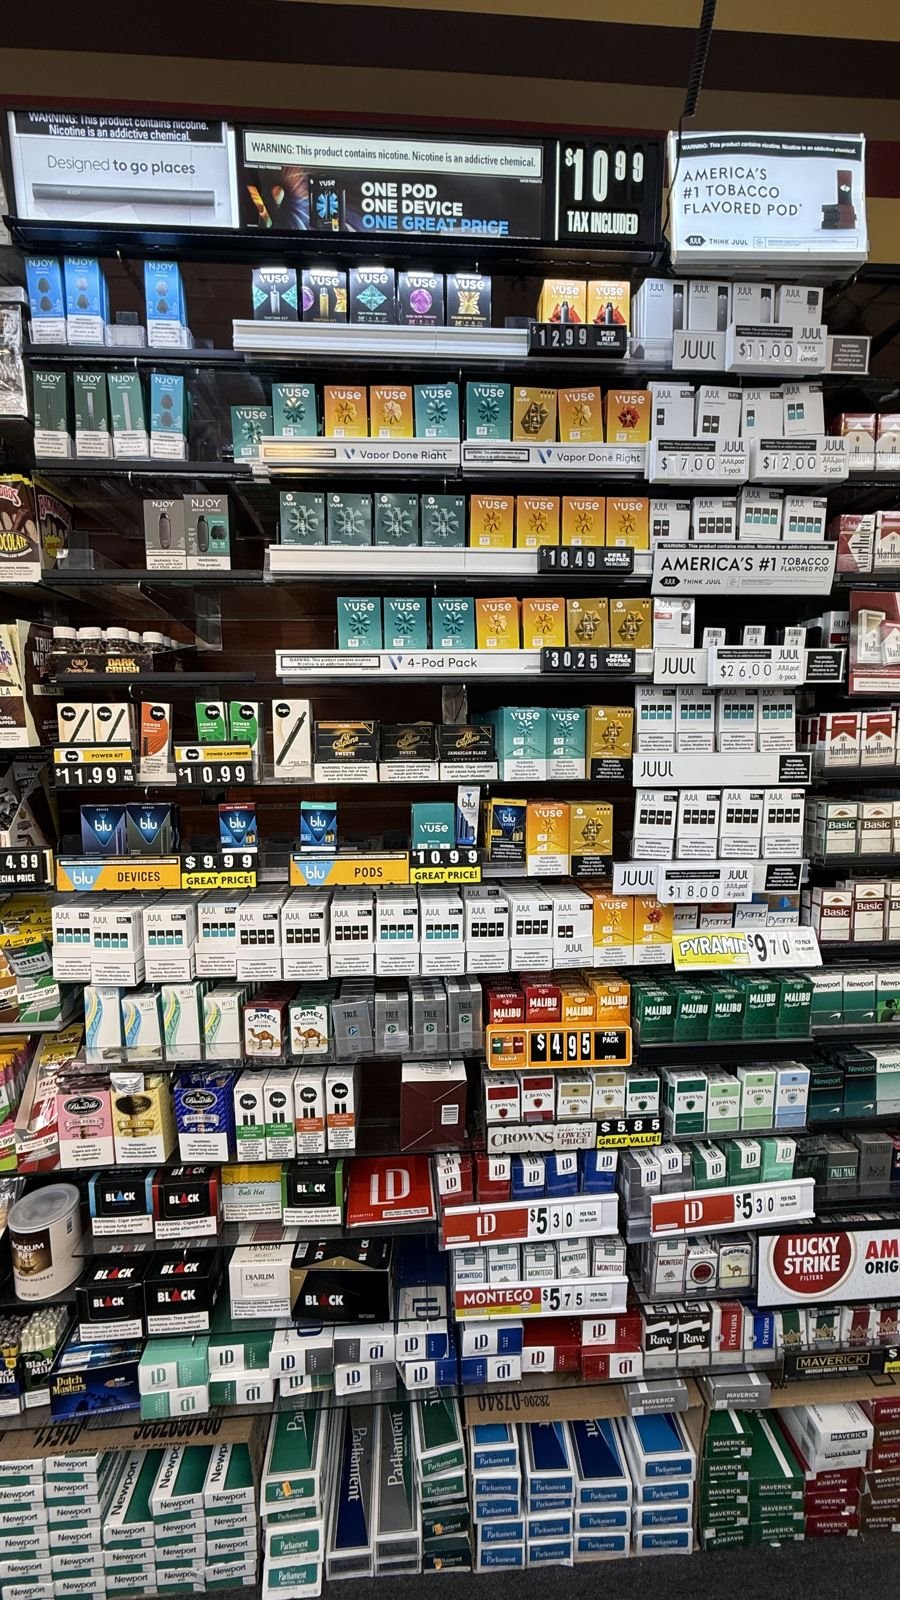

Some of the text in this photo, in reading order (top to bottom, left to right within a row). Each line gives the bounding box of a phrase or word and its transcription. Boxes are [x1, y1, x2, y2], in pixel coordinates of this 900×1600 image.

[29, 112, 208, 130] WARNING: This product contains nicotine.
[49, 124, 191, 141] Nicotine is an addictive chemical.
[251, 141, 295, 154] WARNING:
[296, 145, 312, 156] This
[314, 147, 343, 159] product
[344, 149, 377, 159] contains
[378, 150, 410, 161] nicotine.
[412, 151, 444, 162] Nicotine
[445, 153, 452, 162] is
[465, 155, 499, 165] addictive
[500, 157, 536, 167] chemical.
[48, 155, 196, 175] Designed to go places
[683, 167, 767, 182] AMERICA'S
[361, 182, 437, 198] ONE POD
[683, 184, 779, 198] #1 TOBACCO
[361, 198, 463, 216] ONE DEVICE
[684, 202, 761, 214] FLAVORED
[362, 214, 509, 234] ONE GREAT PRICE
[567, 211, 638, 234] TAX INCLUDED
[29, 259, 54, 267] NJOY
[801, 328, 822, 339] JUUL
[681, 340, 717, 360] JUUL
[723, 440, 745, 453] JUUL
[824, 439, 845, 451] JUUL
[557, 453, 641, 465] Vapor Done Right
[724, 466, 742, 475] 1-pack
[824, 465, 842, 474] 2-pack
[191, 499, 221, 508] NJOY
[661, 556, 776, 572] AMERICA'S #1
[782, 557, 829, 566] TOBACCO
[779, 649, 799, 660] JUUL
[108, 658, 136, 667] DARK
[408, 657, 478, 668] 4-Pod Pack
[662, 657, 695, 674] JUUL
[830, 743, 857, 755] Marlboro
[641, 761, 674, 777] JUUL
[95, 820, 112, 831] blu
[829, 820, 856, 829] Basic
[17, 874, 35, 882] PRICE
[73, 871, 94, 885] blu
[118, 872, 160, 882] DEVICES
[305, 866, 325, 879] blu
[354, 867, 383, 877] PODS
[448, 871, 477, 880] PRICE!
[727, 870, 748, 880] JUUL
[186, 875, 253, 885] GREAT PRICE!
[621, 871, 655, 886] JUUL
[857, 901, 883, 911] Basic
[737, 910, 767, 921] Pyramid
[679, 936, 747, 955] PYRAMID
[847, 980, 874, 989] Newport
[530, 997, 557, 1007] MALIBU
[600, 995, 628, 1006] MALIBU
[248, 1013, 277, 1024] CAMEL
[491, 1131, 553, 1147] CROWNS
[557, 1131, 592, 1139] LOWEST
[561, 1137, 588, 1145] PRICE
[599, 1135, 660, 1145] GREAT VALUE!
[238, 1187, 265, 1197] Bali Hai
[370, 1168, 411, 1206] LD
[105, 1191, 135, 1202] BLACK
[684, 1200, 704, 1224] LD
[476, 1213, 496, 1237] LD
[787, 1236, 840, 1256] LUCKY
[784, 1254, 841, 1275] STRIKE
[245, 1273, 274, 1281] DJARUM
[800, 1274, 823, 1282] FILTERS
[305, 1294, 344, 1306] BLACK
[464, 1289, 533, 1305] MONTEGO
[592, 1323, 606, 1339] LD
[728, 1314, 737, 1347] Fortuna
[650, 1334, 672, 1345] Rave
[800, 1353, 865, 1367] MAVERICK
[56, 1375, 83, 1387] Dutch
[52, 1384, 87, 1396] Masters
[727, 1391, 760, 1399] MAVERICK
[831, 1431, 868, 1441] MAVERICK
[387, 1411, 404, 1486] Parliament
[53, 1460, 88, 1470] Newport
[480, 1456, 510, 1465] Parliament
[111, 1526, 146, 1536] Newport
